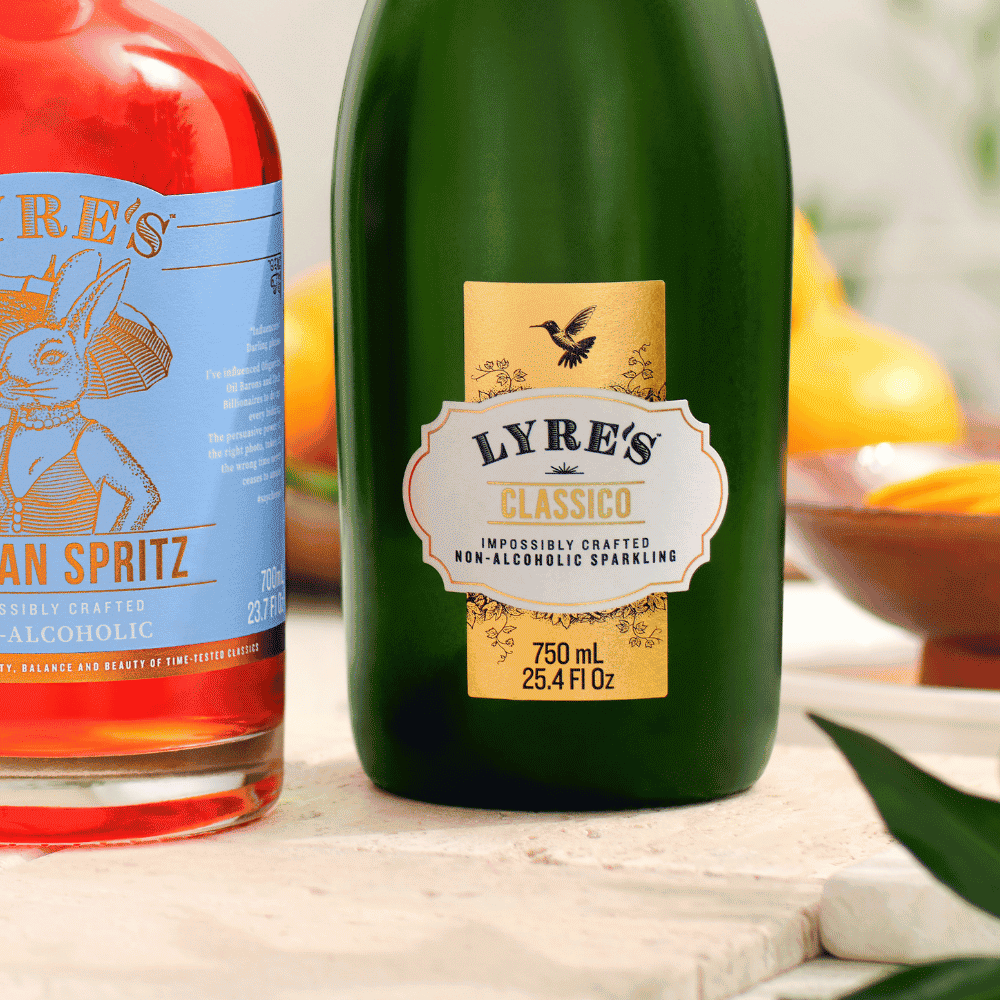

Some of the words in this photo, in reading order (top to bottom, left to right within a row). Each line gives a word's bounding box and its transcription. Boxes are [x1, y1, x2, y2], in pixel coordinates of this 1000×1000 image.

[205, 370, 221, 380] I've
[223, 362, 260, 378] influenced
[226, 382, 238, 393] Oil
[240, 380, 261, 391] Barons
[223, 394, 263, 410] Billionaires
[208, 432, 224, 443] The
[208, 448, 222, 459] the
[224, 446, 243, 458] right
[221, 463, 234, 473] the
[500, 487, 632, 520] CLASSICO
[481, 537, 574, 551] IMPOSSIBLY
[581, 536, 650, 551] CRAFTED
[64, 535, 189, 585] SPRITZ
[455, 549, 583, 567] NON-ALCOHOLIC
[590, 548, 677, 566] SPARKLING
[68, 599, 146, 615] CRAFTED
[247, 598, 268, 624] 23.7
[22, 663, 73, 673] BALANCE
[78, 662, 100, 672] AND
[104, 659, 146, 671] BEAUTY
[150, 658, 162, 668] OF
[166, 650, 225, 666] TIME-TESTED
[227, 642, 260, 658] CLASSICS
[532, 641, 570, 665] 750
[576, 641, 604, 665] mL
[522, 667, 564, 691] 25.4
[569, 667, 586, 691] Fl
[591, 667, 615, 691] Oz
